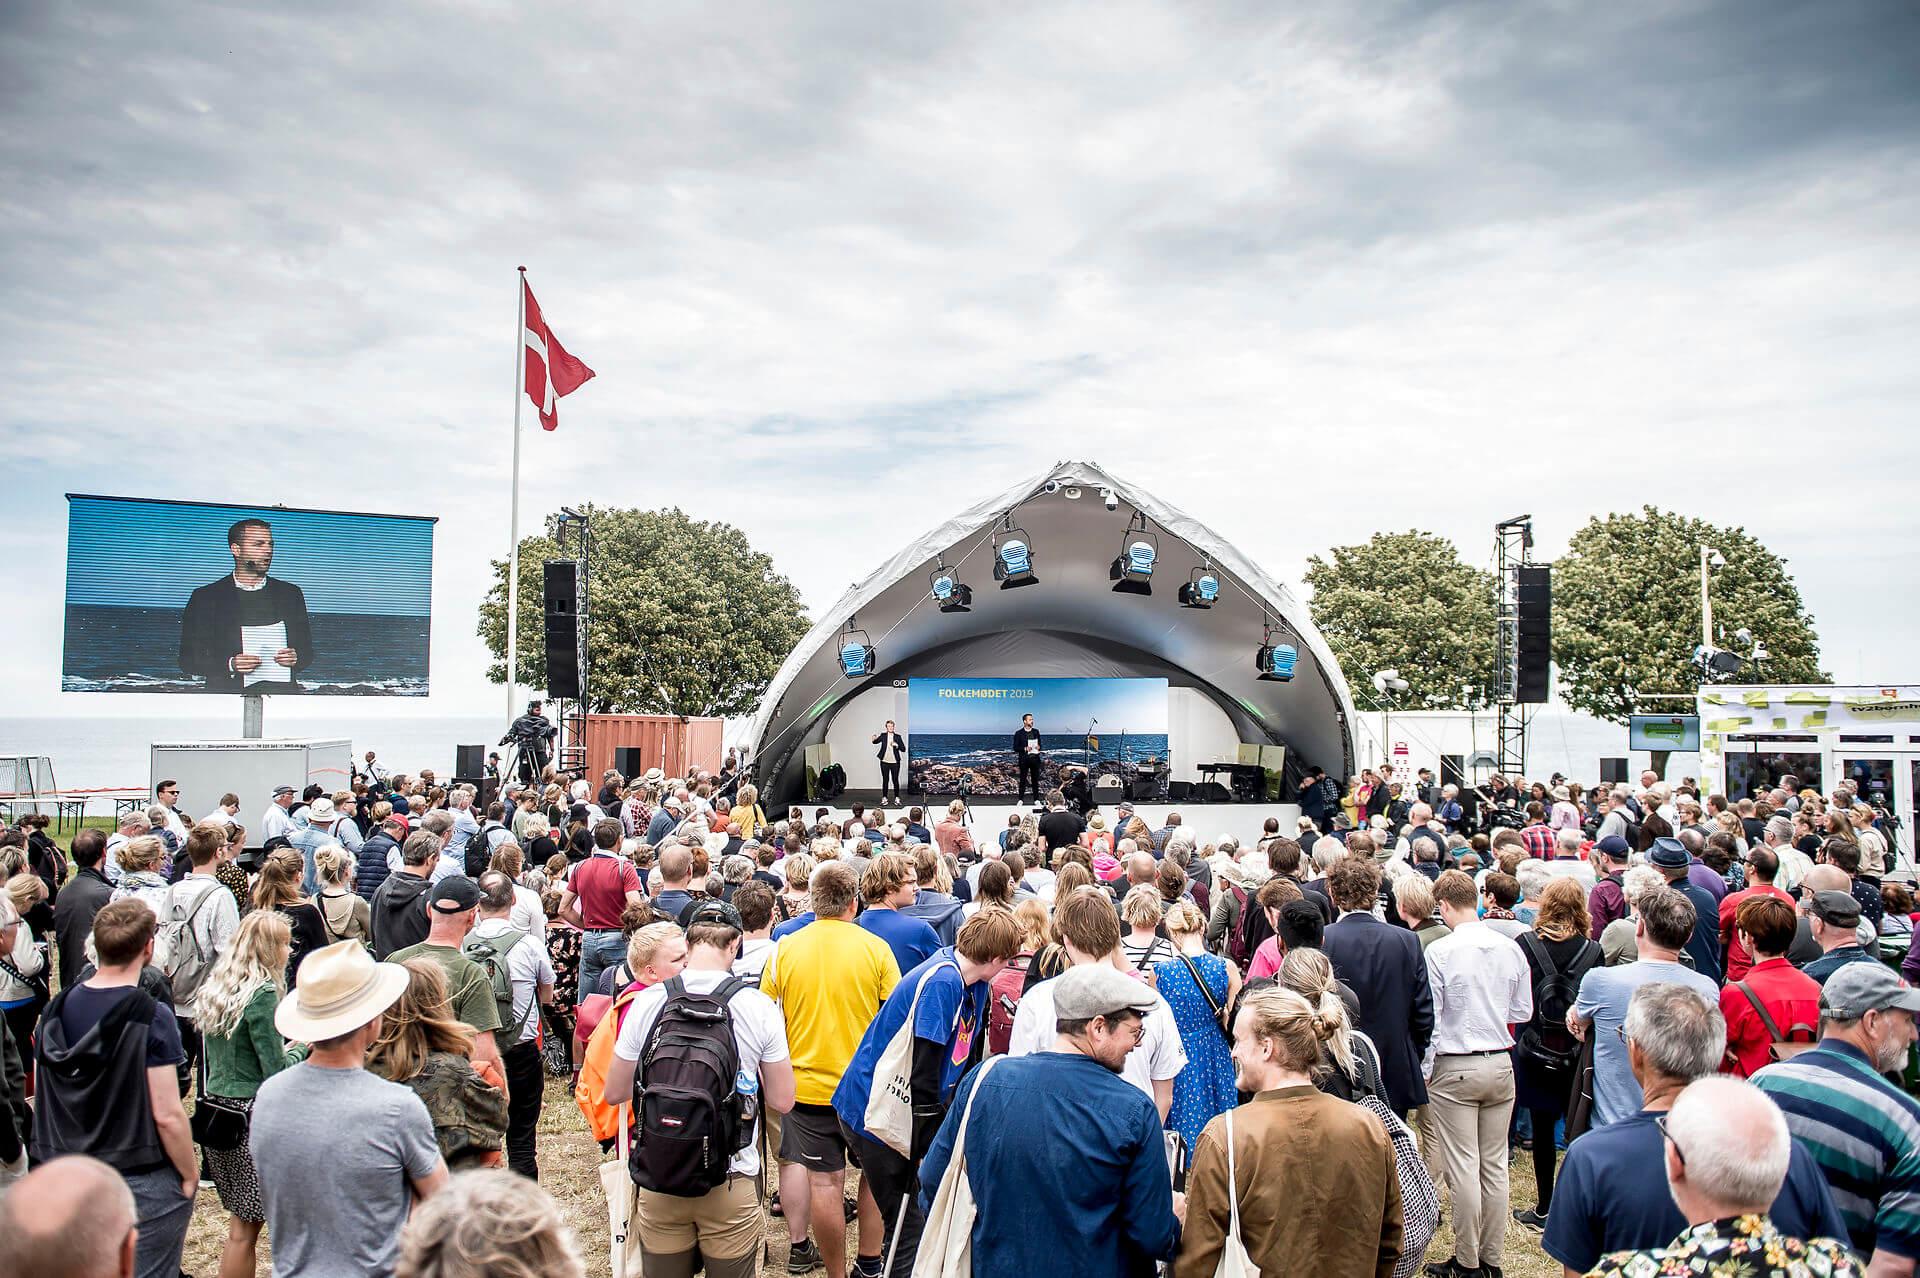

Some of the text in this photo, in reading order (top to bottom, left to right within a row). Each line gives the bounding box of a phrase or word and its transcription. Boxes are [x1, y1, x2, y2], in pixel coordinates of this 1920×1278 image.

[938, 688, 1034, 698] FOLKEMØDET 2019
[1851, 703, 1920, 712] tv2bornh
